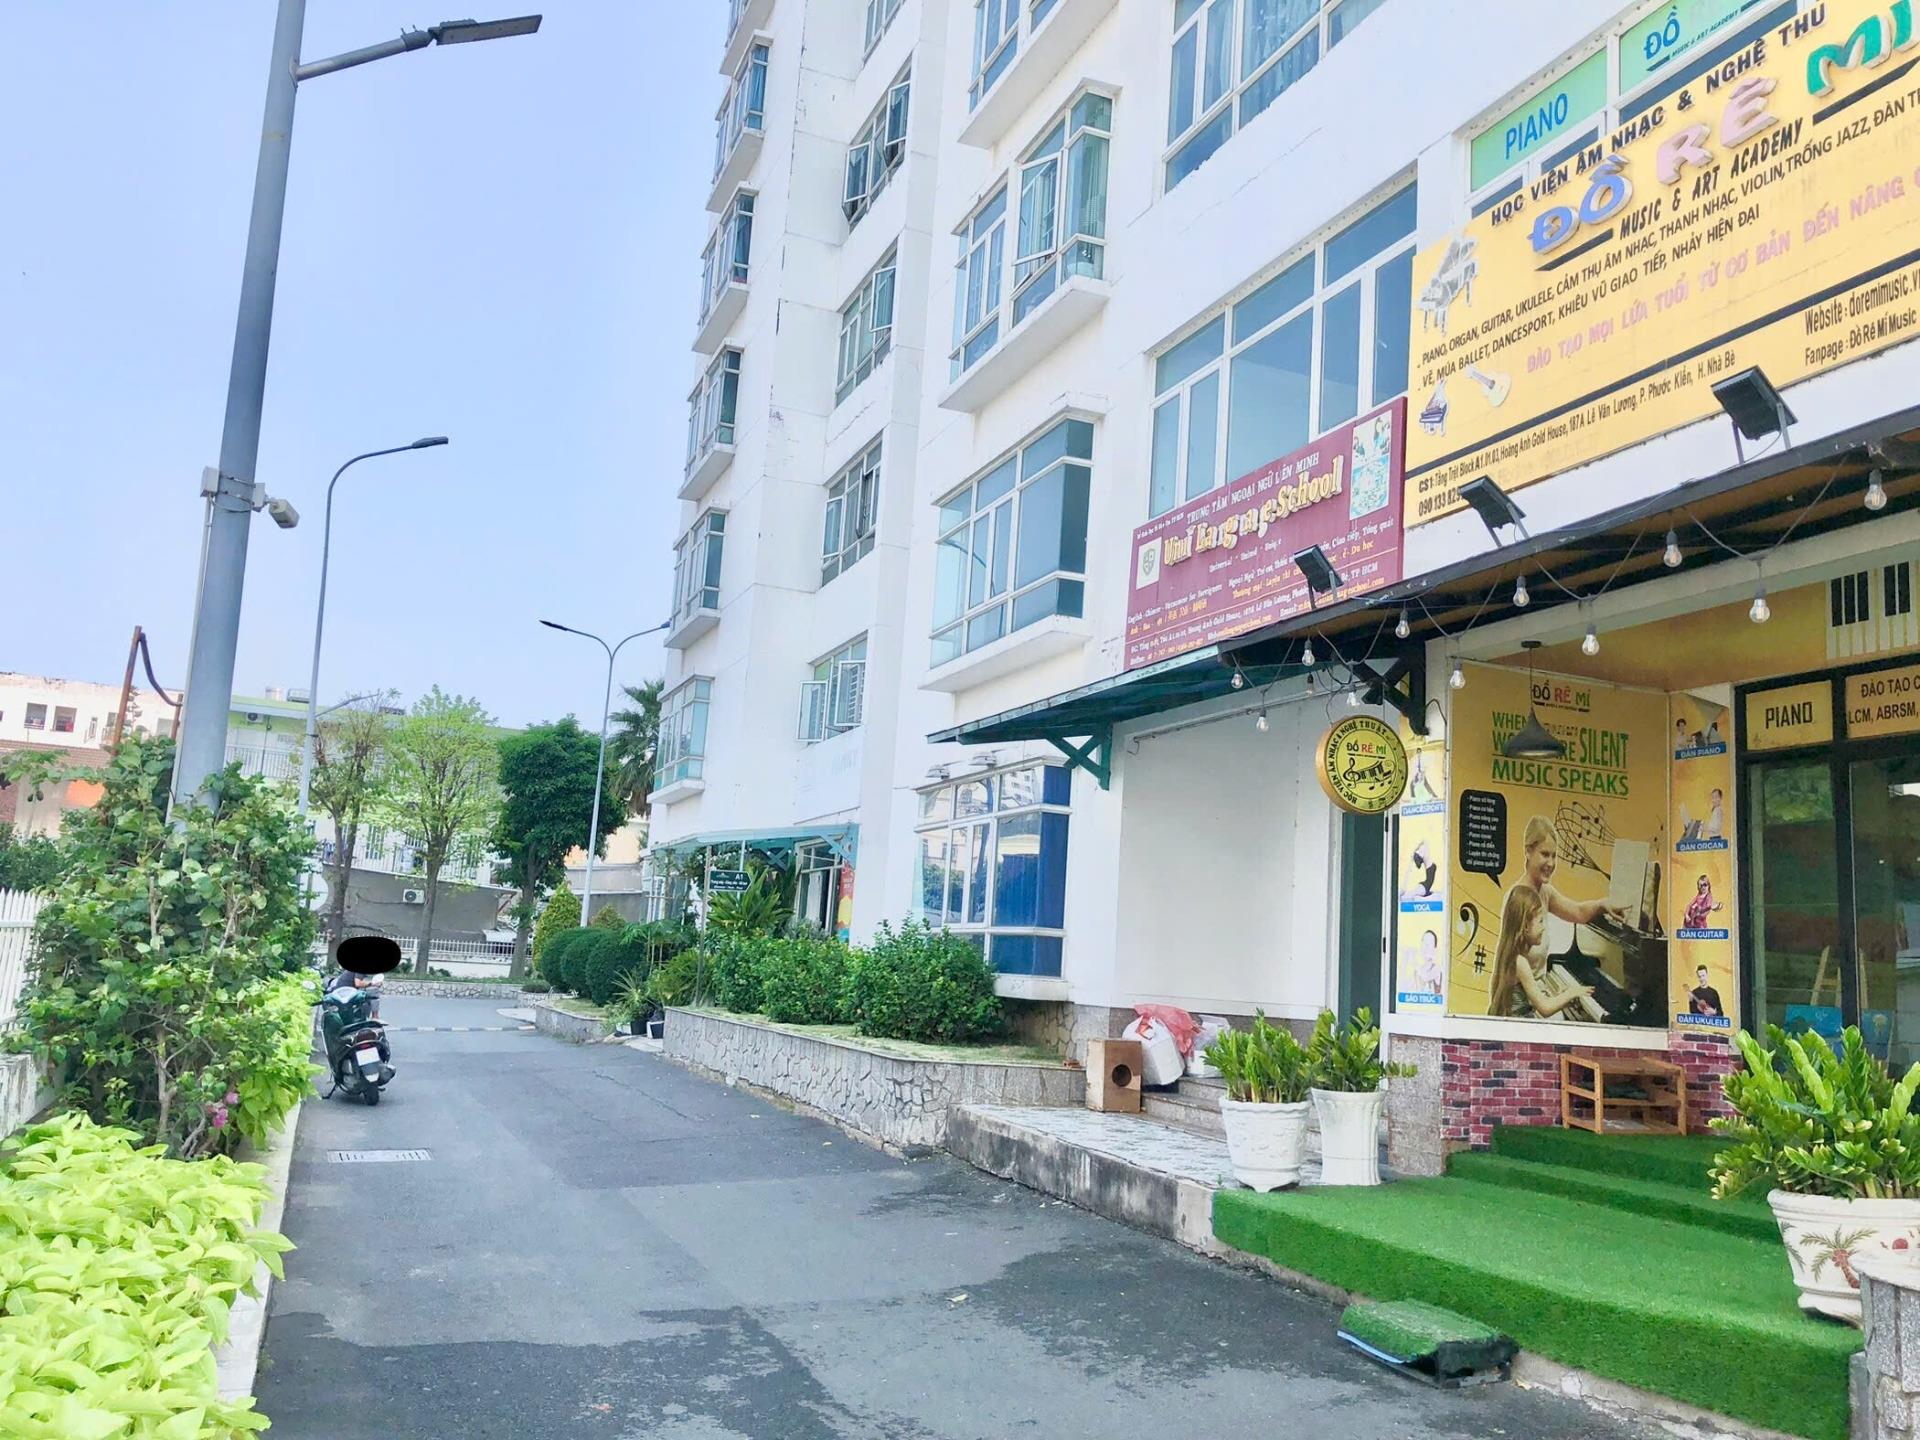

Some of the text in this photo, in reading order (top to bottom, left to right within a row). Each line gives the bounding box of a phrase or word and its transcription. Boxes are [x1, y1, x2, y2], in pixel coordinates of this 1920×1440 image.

[1491, 195, 1524, 226] HỌC
[1531, 165, 1569, 202] VIỆN
[1611, 106, 1664, 152] NHẠC
[1677, 89, 1693, 111] &
[1706, 39, 1766, 94] NGHỆ
[1505, 92, 1568, 160] PIANO
[1527, 153, 1632, 255] ĐỒ
[1656, 77, 1779, 186] RÊ
[1619, 117, 1804, 241] MUSIC & ART ACADEMY
[1422, 342, 1448, 365] PIANO,
[1449, 327, 1480, 351] ORGAN,
[1481, 308, 1514, 335] GUITAR,
[1515, 286, 1555, 317] UKULELE,
[1604, 250, 1622, 272] ÂM
[1625, 232, 1658, 258] NHẠC,
[1659, 208, 1699, 242] THANH
[1702, 187, 1738, 217] NHẠC,
[1741, 162, 1785, 197] VIOLIN,
[1785, 136, 1833, 173] TRỐNG
[1836, 116, 1872, 148] JAZZ,
[1873, 96, 1905, 127] ĐÀN
[1436, 359, 1456, 382] MÚA
[1458, 343, 1491, 371] BALLET,
[1492, 311, 1555, 354] DANCESPORT,
[1558, 290, 1588, 320] KHIÊU
[1592, 280, 1607, 302] VŨ
[1610, 268, 1638, 293] GIAO
[1642, 249, 1667, 276] TIẾP,
[1672, 231, 1703, 262] NHẢY
[1707, 216, 1734, 244] HIỆN
[1738, 204, 1760, 227] ĐẠI
[1527, 346, 1552, 374] ĐÀO
[1557, 332, 1584, 363] TẠO
[1588, 318, 1614, 341] MỌI
[1725, 249, 1749, 280] CƠ
[1755, 229, 1792, 265] BẢN
[1802, 201, 1840, 242] ĐẾN
[1849, 175, 1905, 221] NÂNG
[1805, 298, 1843, 336] Website
[1805, 338, 1844, 366] Fanpage
[1889, 307, 1917, 334] Music
[1459, 459, 1475, 477] Block
[1500, 443, 1519, 461] Hoàng
[1519, 436, 1531, 451] Anh
[1531, 429, 1546, 448] Gold
[1547, 422, 1569, 443] House,
[1587, 410, 1596, 425] Lê
[1598, 404, 1611, 421] Văn
[1640, 387, 1647, 404] P.
[1648, 376, 1672, 400] Phước
[1697, 363, 1706, 380] H.
[1707, 355, 1722, 374] Nhà
[1724, 349, 1736, 368] Bè
[1186, 504, 1210, 525] TRUNG
[1211, 495, 1228, 512] TÂM
[1231, 483, 1255, 504] NGOẠI
[1295, 452, 1319, 474] MINH
[1418, 497, 1433, 517] 090
[1887, 677, 1910, 697] TẠO
[1765, 701, 1813, 729] PIANO
[1849, 701, 1919, 724] LCM, ABRSM,
[1579, 727, 1629, 769] SILENT
[1492, 758, 1629, 797] MUSIC SPEAKS
[1697, 842, 1724, 850] ORGAN
[1413, 903, 1430, 911] YOGA
[1697, 930, 1724, 938] GUITAR
[1695, 1016, 1729, 1027] UKULELE
